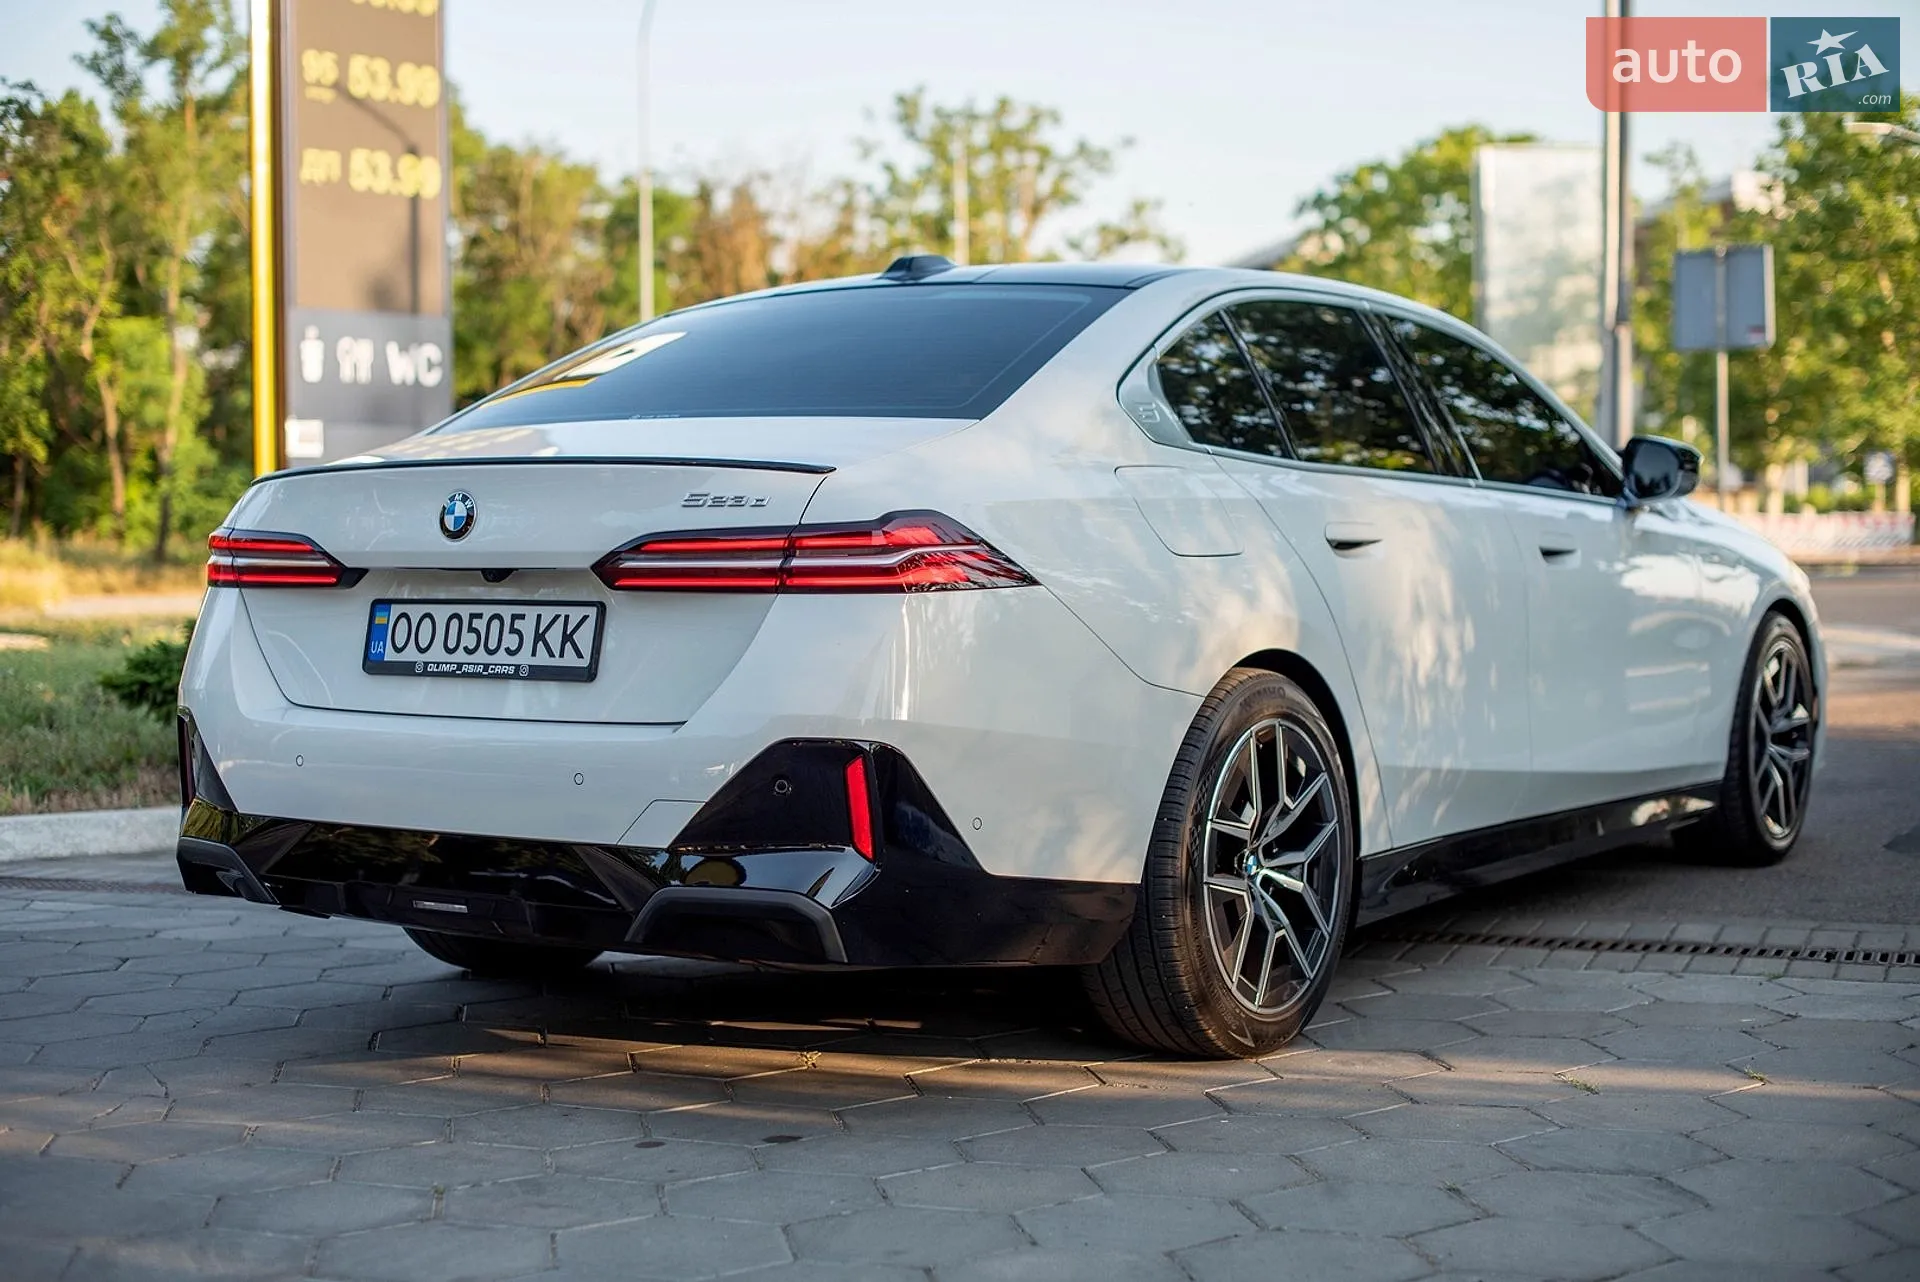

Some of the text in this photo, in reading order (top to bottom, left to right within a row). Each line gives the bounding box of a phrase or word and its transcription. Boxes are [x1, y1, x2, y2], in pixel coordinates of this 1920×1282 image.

[386, 341, 442, 387] WC
[371, 640, 385, 654] UA
[443, 612, 526, 656] 0505
[531, 613, 590, 659] KK
